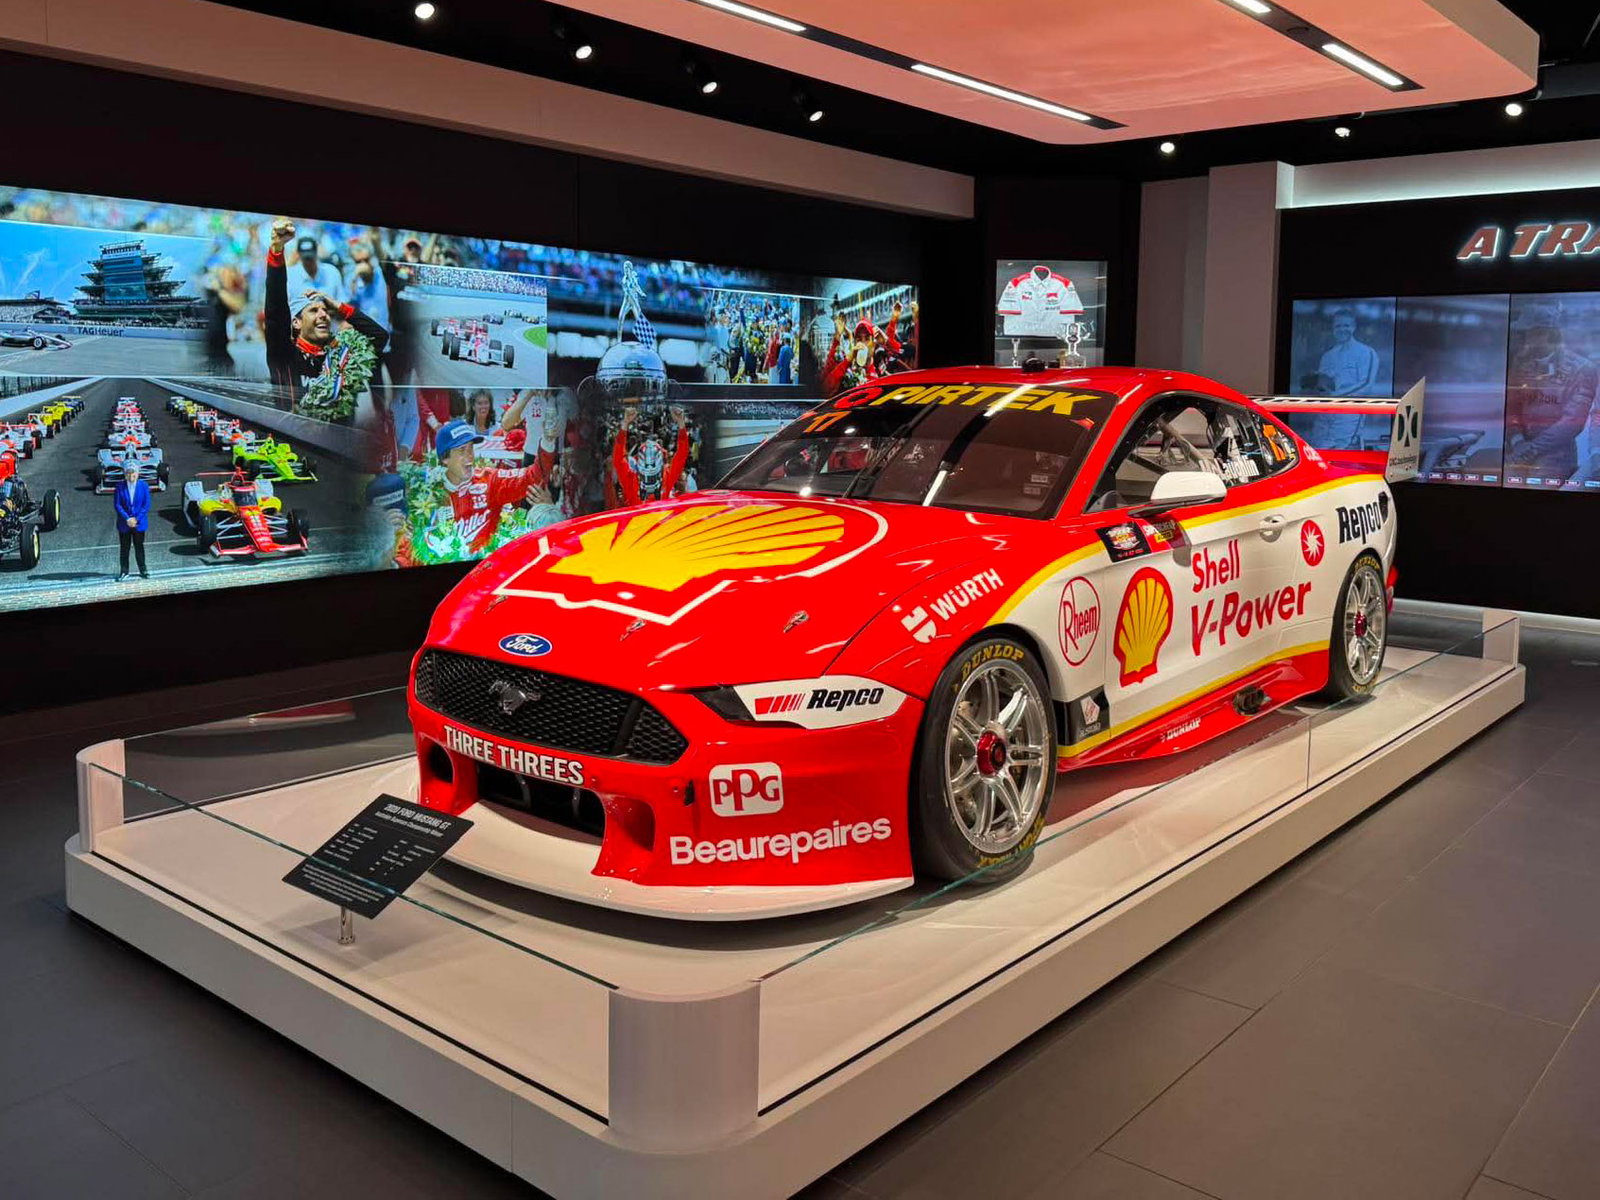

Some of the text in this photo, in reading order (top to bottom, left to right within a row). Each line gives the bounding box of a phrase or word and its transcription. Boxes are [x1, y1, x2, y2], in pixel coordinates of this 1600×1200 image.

[1456, 225, 1500, 259] A
[869, 385, 1103, 415] PIRTEK
[803, 410, 851, 433] 17
[1335, 502, 1381, 544] Repco
[1192, 539, 1239, 593] Shell
[930, 568, 1004, 621] WÜRTH
[1063, 582, 1099, 654] Rheem
[1191, 581, 1312, 656] V-Power
[506, 634, 543, 653] Ford
[961, 644, 1025, 681] DUNLOP
[806, 687, 884, 711] Repco
[443, 725, 584, 785] THREE THREES
[712, 769, 780, 811] PPG
[669, 817, 892, 864] Beaurepaires
